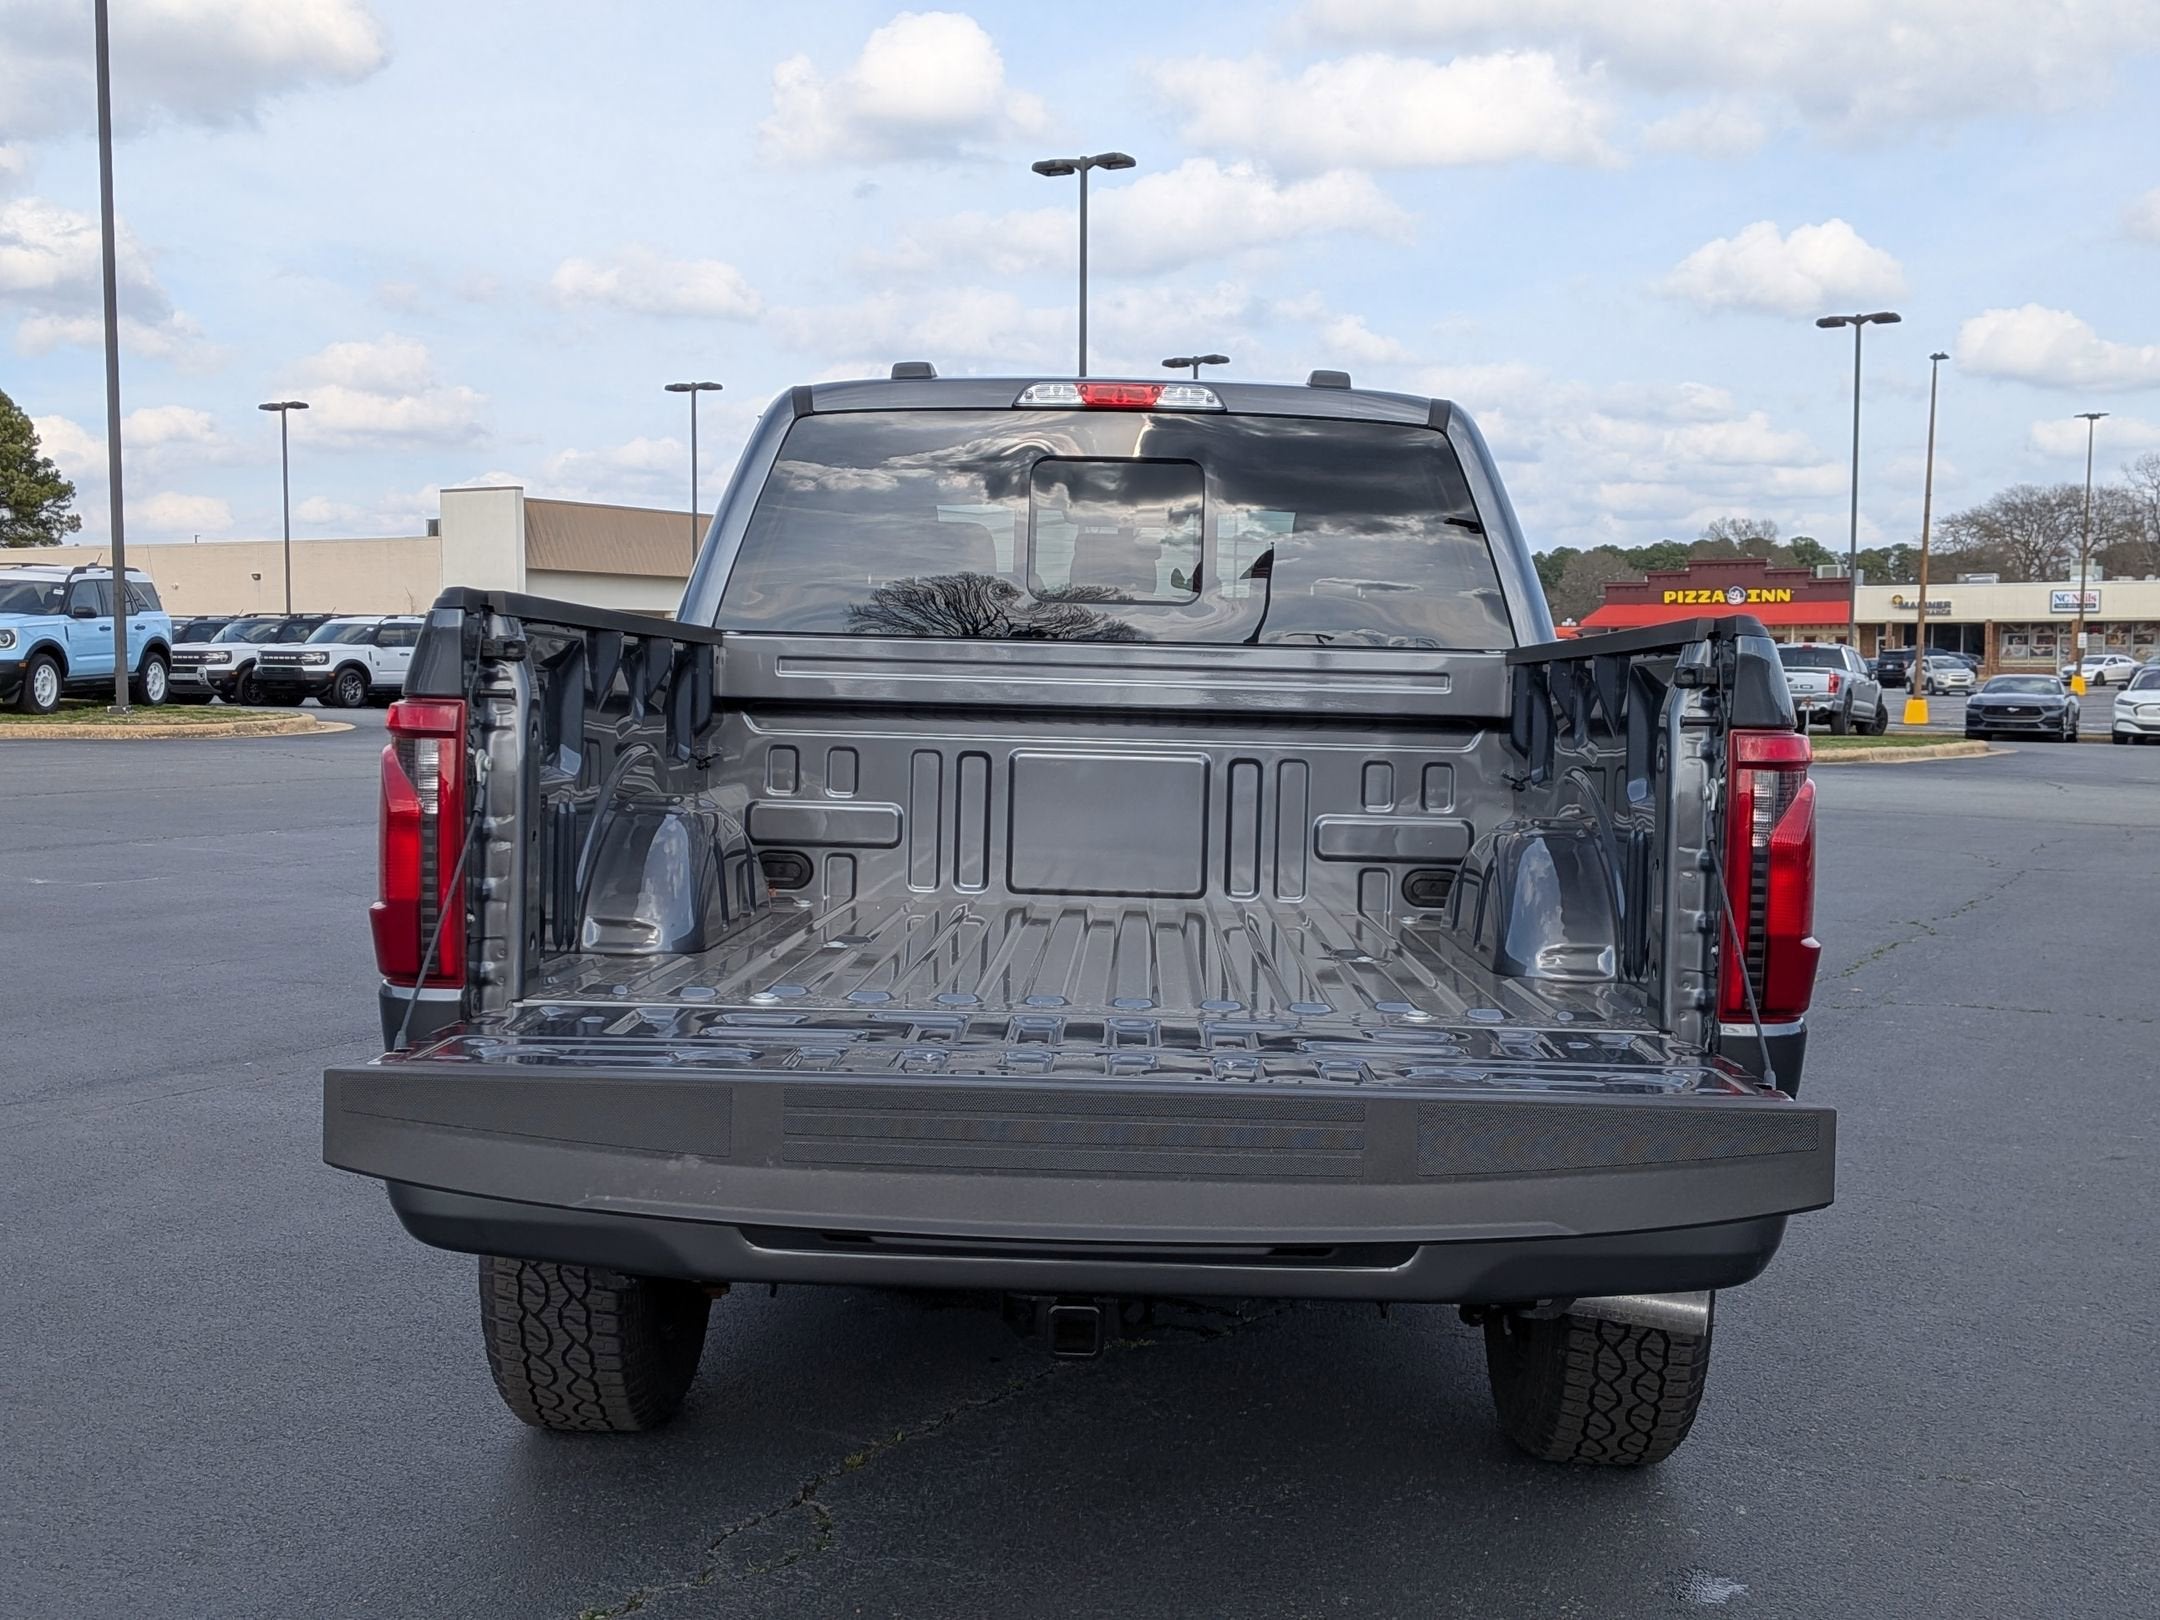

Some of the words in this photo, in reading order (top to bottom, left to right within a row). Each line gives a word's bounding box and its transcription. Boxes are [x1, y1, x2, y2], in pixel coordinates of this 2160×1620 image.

[1663, 590, 1726, 604] PIZZA
[1747, 589, 1791, 603] INN
[2054, 593, 2070, 602] NC
[2072, 592, 2097, 603] Nils
